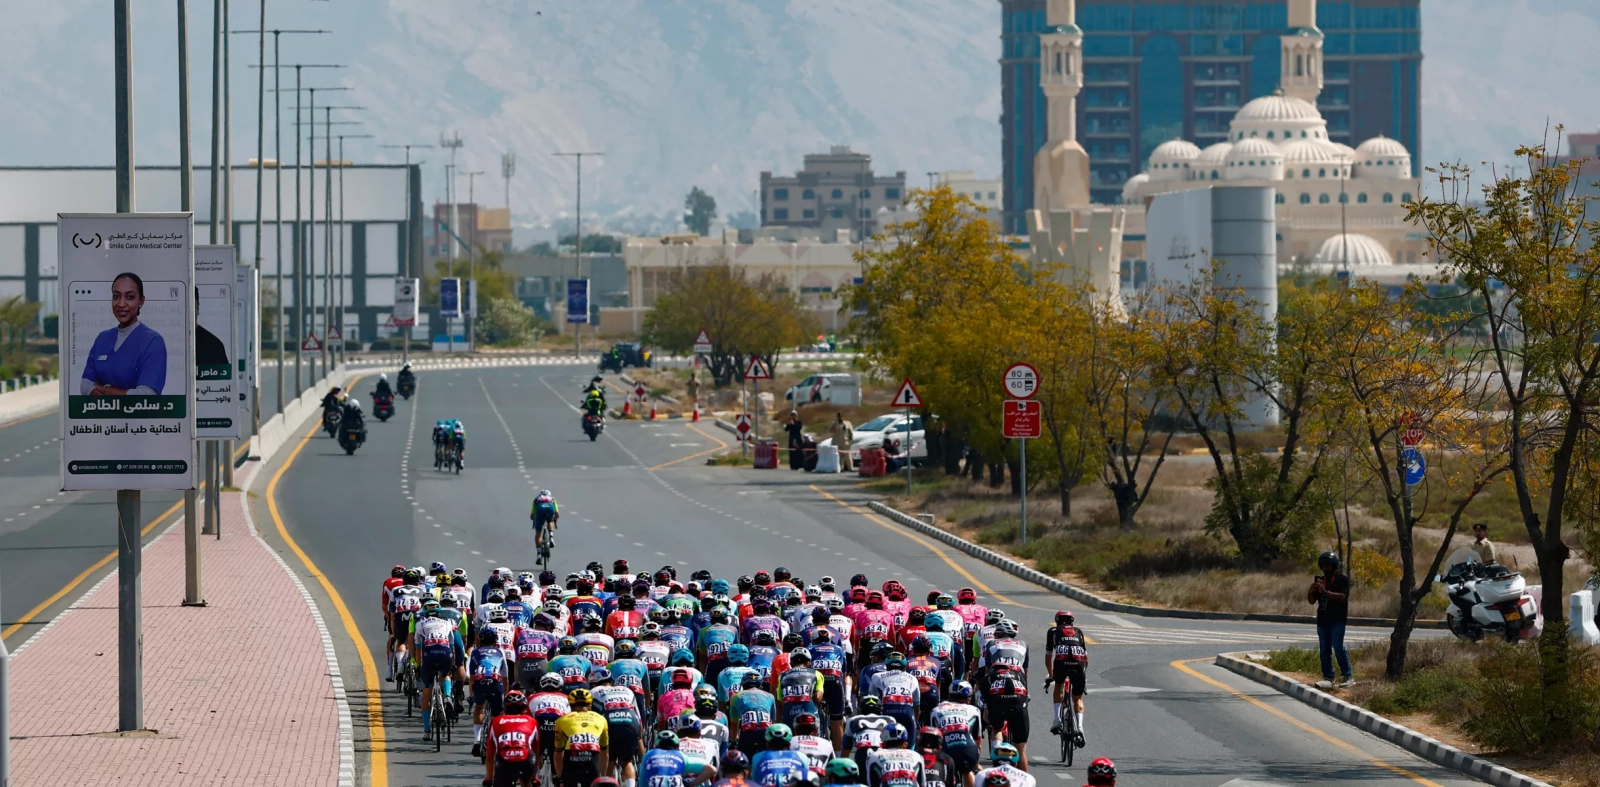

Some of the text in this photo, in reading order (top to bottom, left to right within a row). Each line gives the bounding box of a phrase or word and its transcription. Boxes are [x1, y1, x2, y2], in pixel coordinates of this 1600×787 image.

[200, 368, 218, 378] ماهر
[82, 399, 174, 413] د. سلمى الطاهر
[70, 422, 181, 436] أخصائية طب أسنان الأطفال
[885, 687, 896, 695] 23
[945, 733, 966, 742] BORA
